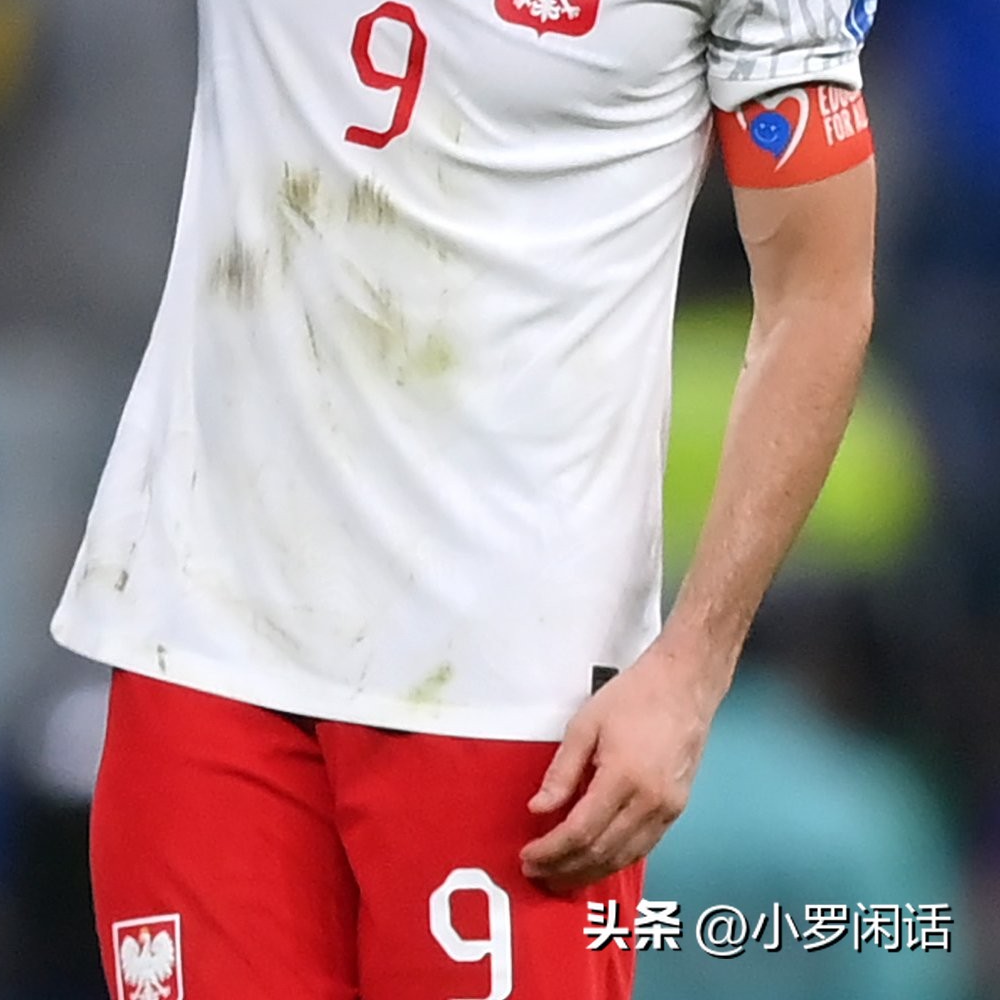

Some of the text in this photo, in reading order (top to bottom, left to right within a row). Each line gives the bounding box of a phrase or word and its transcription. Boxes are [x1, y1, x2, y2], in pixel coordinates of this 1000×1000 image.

[344, 0, 427, 150] 9
[823, 108, 856, 146] FOR
[428, 867, 513, 1000] 9
